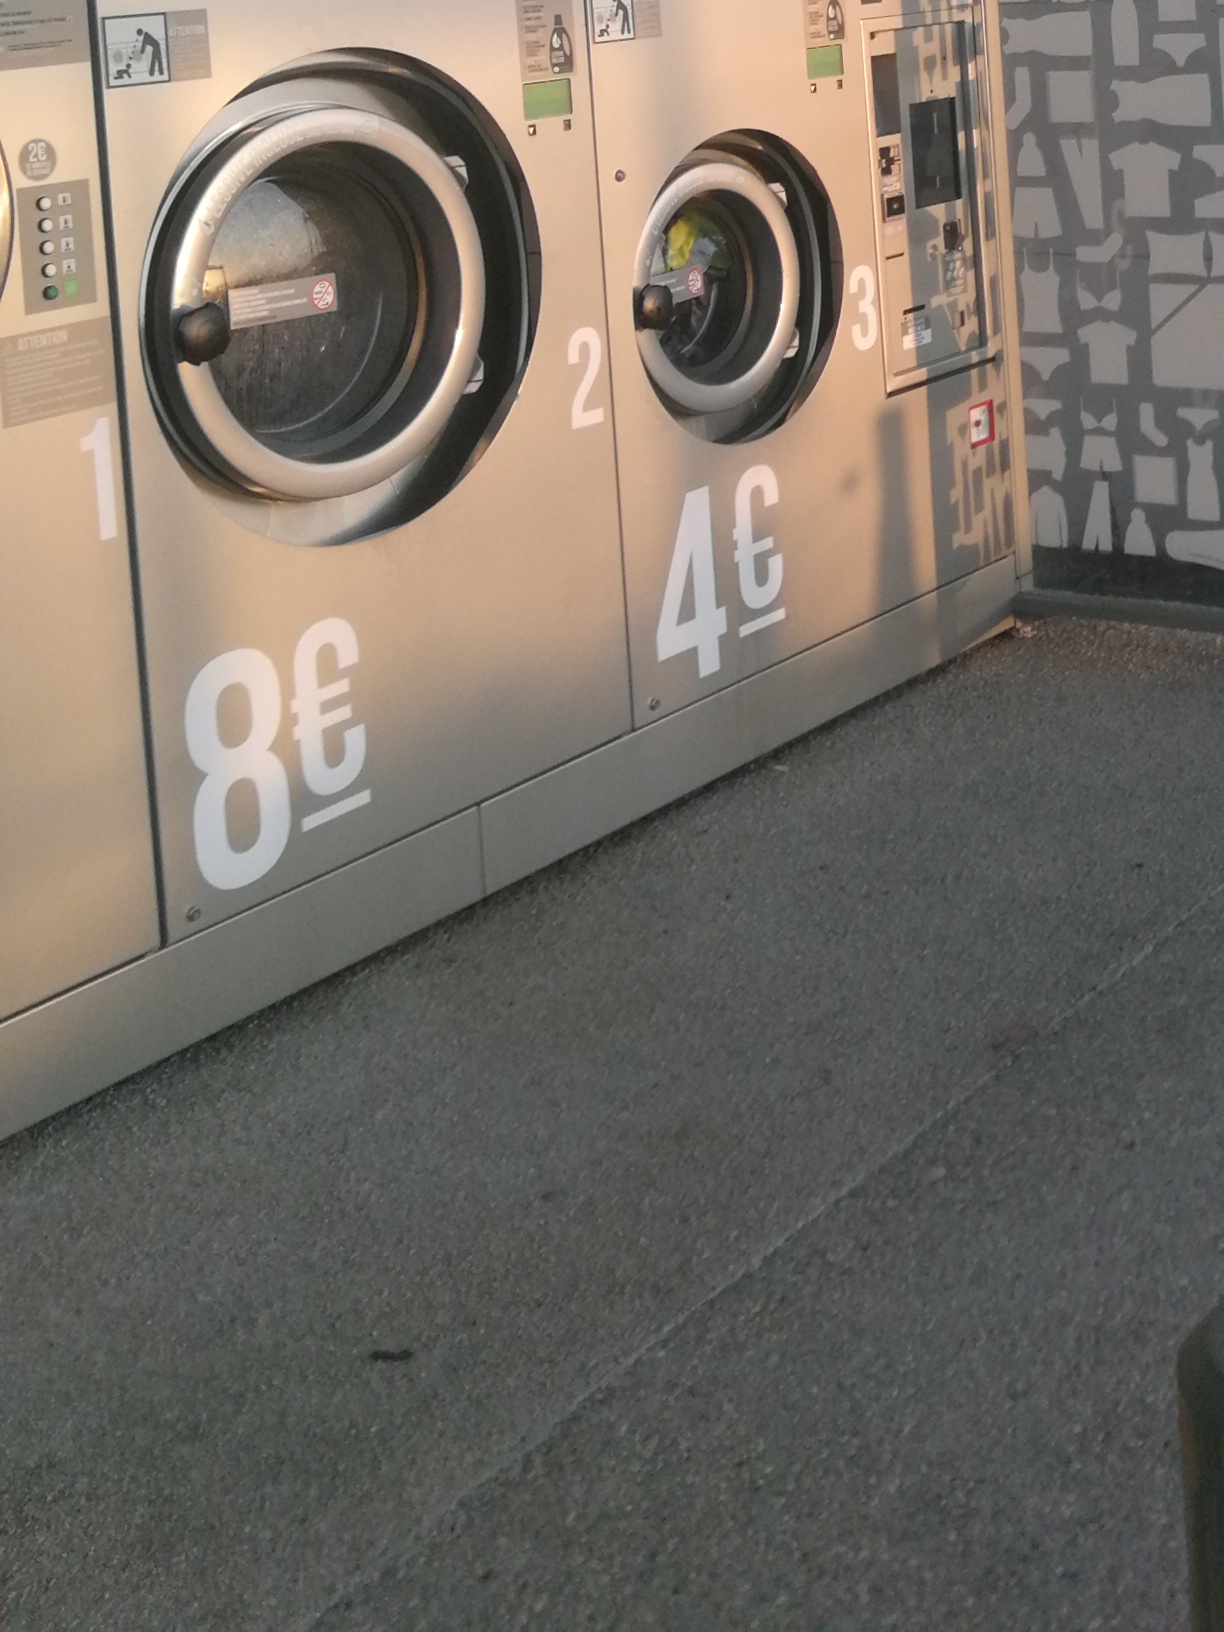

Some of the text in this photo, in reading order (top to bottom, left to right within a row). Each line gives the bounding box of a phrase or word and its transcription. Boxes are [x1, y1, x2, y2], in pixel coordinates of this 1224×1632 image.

[29, 142, 47, 162] 2€
[17, 329, 68, 352] ATTENTION
[848, 264, 878, 351] 3
[567, 327, 605, 430] 2
[80, 416, 118, 541] 1
[656, 464, 785, 679] 4€
[184, 617, 367, 891] 8€
